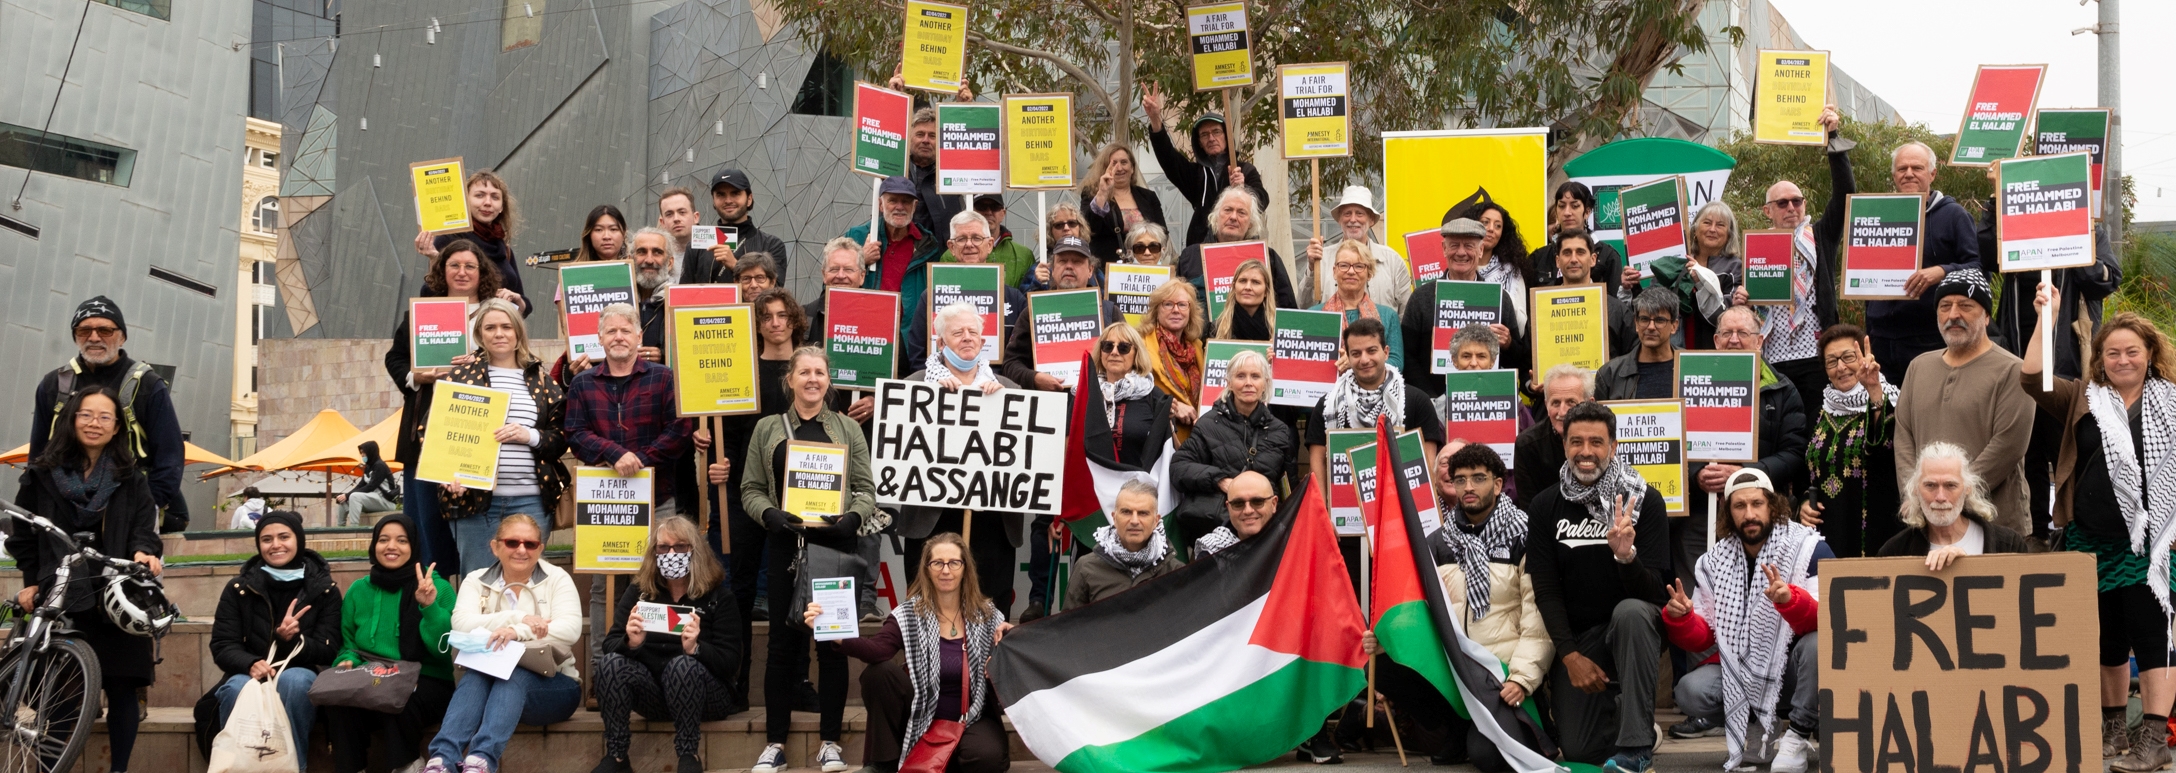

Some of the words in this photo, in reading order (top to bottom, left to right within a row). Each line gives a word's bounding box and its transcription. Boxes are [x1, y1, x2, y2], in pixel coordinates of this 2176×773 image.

[1212, 14, 1228, 22] FAIR
[919, 20, 952, 31] ANOTHER
[1201, 24, 1220, 32] TRIAL
[1200, 33, 1239, 44] MOHAMMED
[920, 44, 947, 55] BEHIND
[1213, 42, 1237, 52] HALABI
[1774, 69, 1811, 79] ANOTHER
[1302, 77, 1307, 85] A
[1309, 76, 1326, 85] FAIR
[1295, 86, 1316, 94] TRIAL
[1318, 85, 1333, 93] FOR
[1293, 98, 1337, 109] MOHAMMED
[1776, 95, 1807, 104] BEHIND
[1296, 109, 1306, 117] EL
[1307, 107, 1334, 116] HALABI
[1975, 103, 1999, 111] FREE
[1022, 116, 1055, 125] ANOTHER
[1973, 112, 2022, 121] MOHAMMED
[862, 117, 881, 128] FREE
[943, 123, 967, 132] FREE
[1969, 122, 1981, 130] EL
[1982, 122, 2015, 131] HALABI
[862, 125, 902, 142] MOHAMMED
[943, 132, 996, 142] MOHAMMED
[2040, 132, 2067, 143] FREE
[862, 134, 871, 143] EL
[872, 136, 898, 149] HALABI
[943, 142, 955, 150] EL
[957, 142, 992, 150] HALABI
[1026, 140, 1053, 149] BEHIND
[2039, 143, 2100, 154] MOHAMMED
[425, 176, 452, 186] ANOTHER
[2007, 180, 2040, 193] FREE
[430, 195, 453, 204] BEHIND
[2007, 188, 2082, 205] MOHAMMED
[1627, 204, 1648, 217] FREE
[2007, 206, 2024, 217] EL
[2026, 200, 2076, 215] HALABI
[1628, 207, 1676, 226] MOHAMMED
[1854, 217, 1881, 226] FREE
[1629, 227, 1641, 236] EL
[1641, 218, 1674, 233] HALABI
[1854, 227, 1913, 237] MOHAMMED
[1853, 238, 1866, 247] EL
[1868, 238, 1908, 247] HALABI
[1419, 262, 1441, 273] FREE
[1127, 275, 1132, 283] A
[1134, 275, 1151, 283] FAIR
[568, 284, 595, 295] FREE
[935, 285, 962, 294] FREE
[1120, 283, 1140, 292] TRIAL
[569, 292, 629, 305] MOHAMMED
[935, 295, 994, 305] MOHAMMED
[570, 305, 584, 314] EL
[1120, 304, 1128, 313] EL
[1440, 300, 1465, 309] FREE
[1439, 310, 1495, 320] MOHAMMED
[1551, 307, 1587, 318] ANOTHER
[1036, 313, 1063, 324] FREE
[1037, 320, 1096, 334] MOHAMMED
[1439, 320, 1452, 329] EL
[693, 329, 734, 340] ANOTHER
[834, 325, 859, 335] FREE
[1277, 329, 1303, 339] FREE
[834, 334, 888, 347] MOHAMMED
[1038, 335, 1052, 344] EL
[1053, 331, 1092, 343] HALABI
[1555, 334, 1585, 344] BEHIND
[693, 343, 737, 355] BIRTHDAY
[833, 344, 845, 353] EL
[847, 345, 883, 356] HALABI
[1277, 339, 1335, 352] MOHAMMED
[1276, 351, 1289, 360] EL
[1291, 351, 1330, 362] HALABI
[700, 358, 733, 369] BEHIND
[839, 369, 857, 377] APAN
[705, 373, 729, 384] BARS
[1206, 379, 1219, 387] EL
[1684, 376, 1712, 385] FREE
[1452, 391, 1478, 401] FREE
[1684, 386, 1748, 396] MOHAMMED
[1452, 401, 1511, 412] MOHAMMED
[1684, 398, 1698, 408] EL
[1701, 398, 1742, 408] HALABI
[449, 404, 490, 418] ANOTHER
[881, 383, 983, 427] FREE
[1000, 394, 1056, 435] EL
[1452, 412, 1465, 422] EL
[1467, 412, 1506, 422] HALABI
[1627, 417, 1634, 426] A
[1636, 416, 1657, 426] FAIR
[1619, 427, 1646, 437] TRIAL
[1648, 427, 1666, 437] FOR
[447, 431, 481, 445] BEHIND
[876, 423, 1034, 470] HALABI
[1617, 442, 1670, 453] MOHAMMED
[805, 453, 812, 462] A
[812, 454, 828, 463] FAIR
[1621, 454, 1631, 464] EL
[1634, 453, 1666, 464] HALABI
[459, 463, 481, 471] AMNESTY
[799, 461, 819, 470] TRIAL
[820, 462, 833, 471] FOR
[795, 471, 835, 483] MOHAMMED
[1334, 476, 1348, 486] EL
[600, 479, 606, 489] A
[608, 479, 628, 489] FAIR
[798, 480, 807, 489] EL
[807, 481, 832, 491] HALABI
[591, 490, 617, 500] TRIAL
[619, 490, 636, 500] FOR
[587, 504, 640, 515] MOHAMMED
[591, 515, 602, 525] EL
[603, 515, 636, 526] HALABI
[602, 541, 630, 549] AMNESTY
[1829, 573, 2070, 671] FREE
[1819, 683, 2082, 773] HALABI
